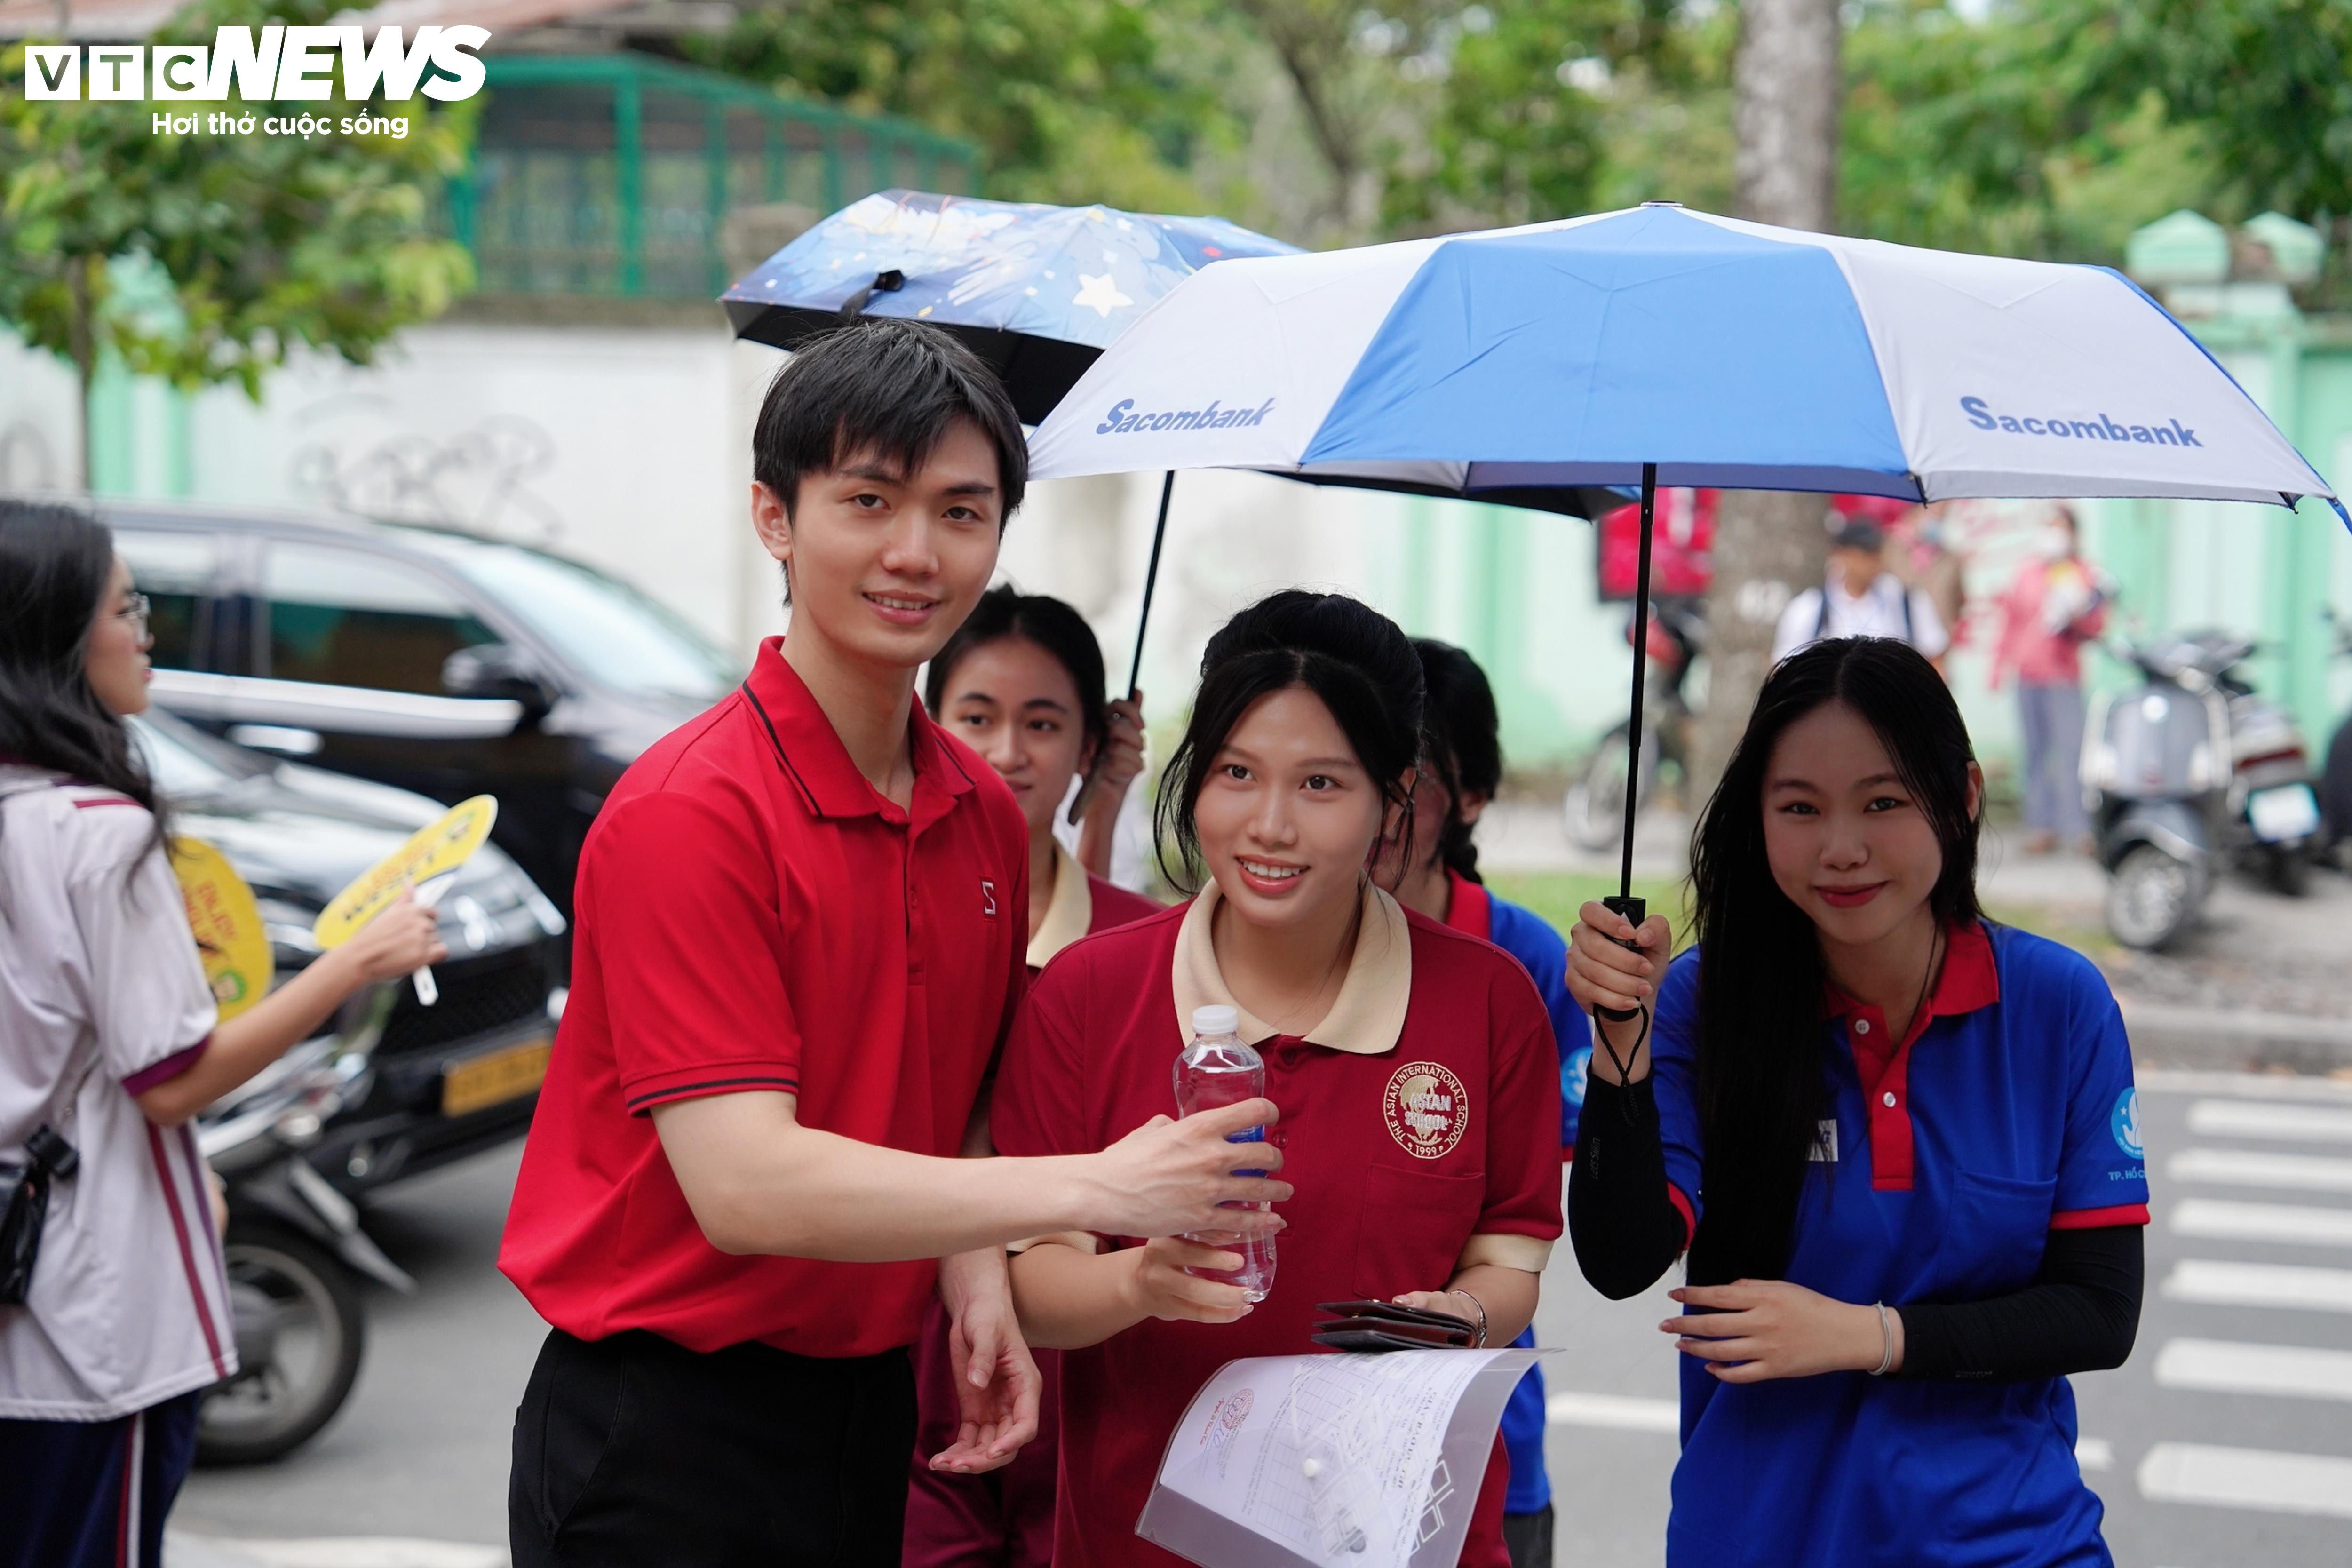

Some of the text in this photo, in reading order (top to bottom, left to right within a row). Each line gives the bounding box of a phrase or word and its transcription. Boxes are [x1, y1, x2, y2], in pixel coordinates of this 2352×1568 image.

[1096, 397, 1276, 434] Sacombank
[1960, 396, 2204, 447] Sacombank
[1387, 1065, 1466, 1146] THE ASIAN INTERNATIONAL SCHOOL
[1410, 1092, 1452, 1111] ASIAN
[1415, 1145, 1437, 1156] 1999
